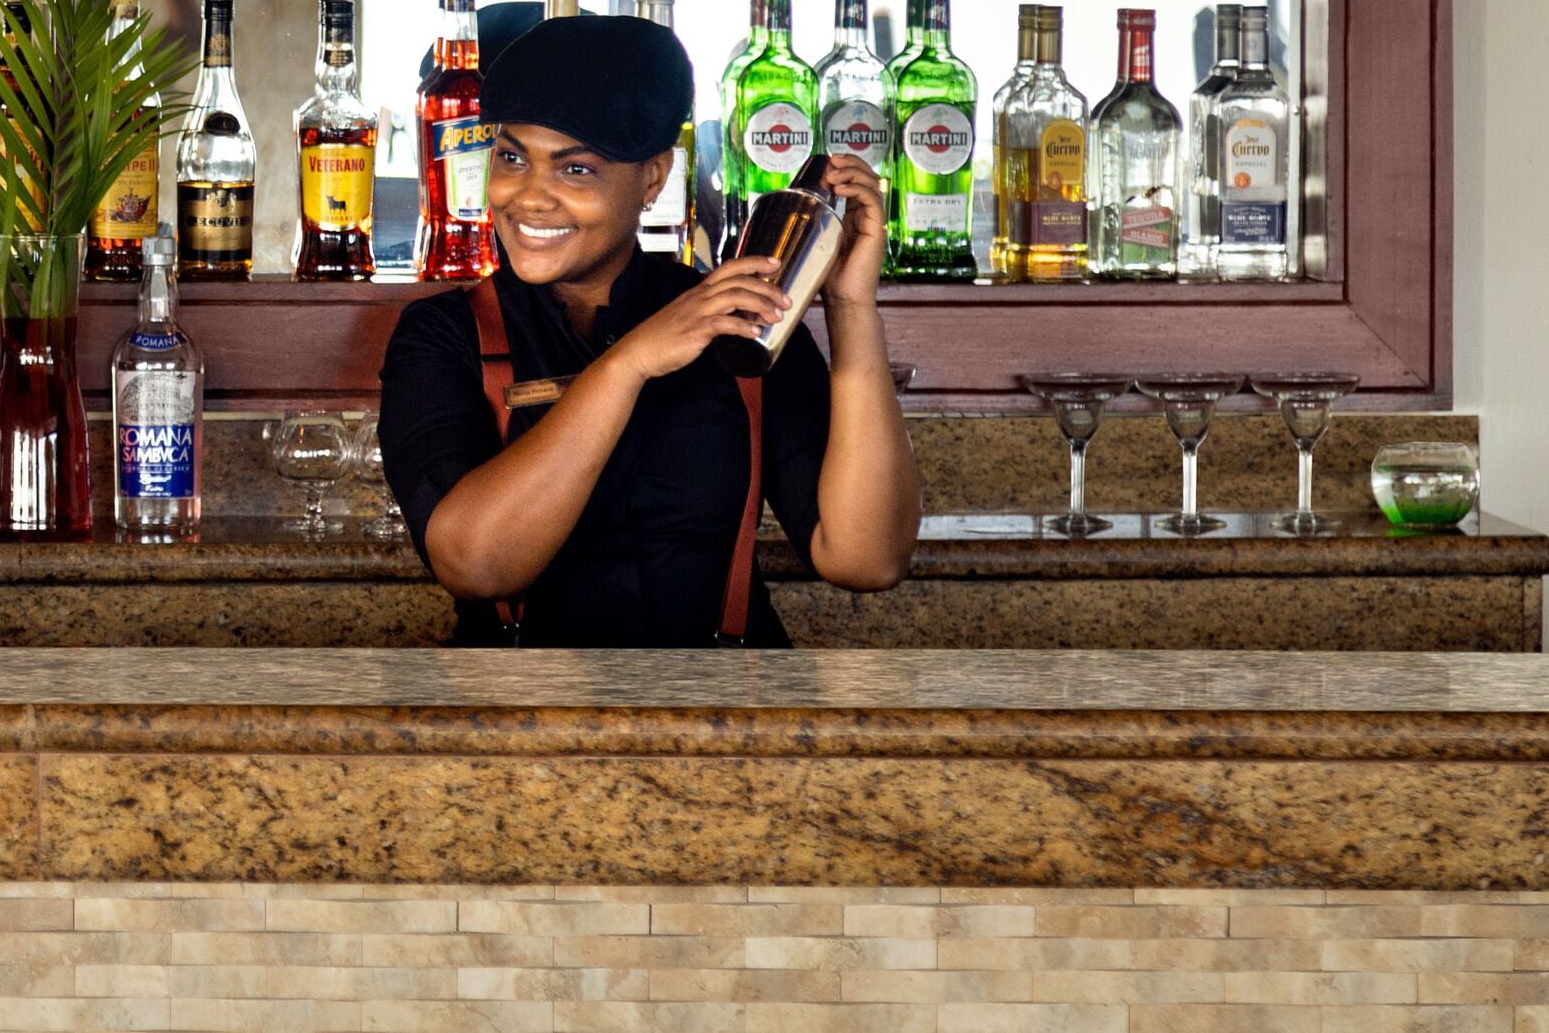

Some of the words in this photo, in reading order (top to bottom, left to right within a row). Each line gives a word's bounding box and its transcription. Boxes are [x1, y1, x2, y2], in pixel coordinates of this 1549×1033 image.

[753, 132, 807, 144] MARTINI
[832, 130, 887, 143] MARTINI
[911, 132, 967, 145] MARTINI
[309, 156, 366, 172] VETERANO
[135, 335, 179, 348] ROMANA
[120, 427, 193, 447] ROMANA
[122, 445, 190, 464] SAMBVCA
